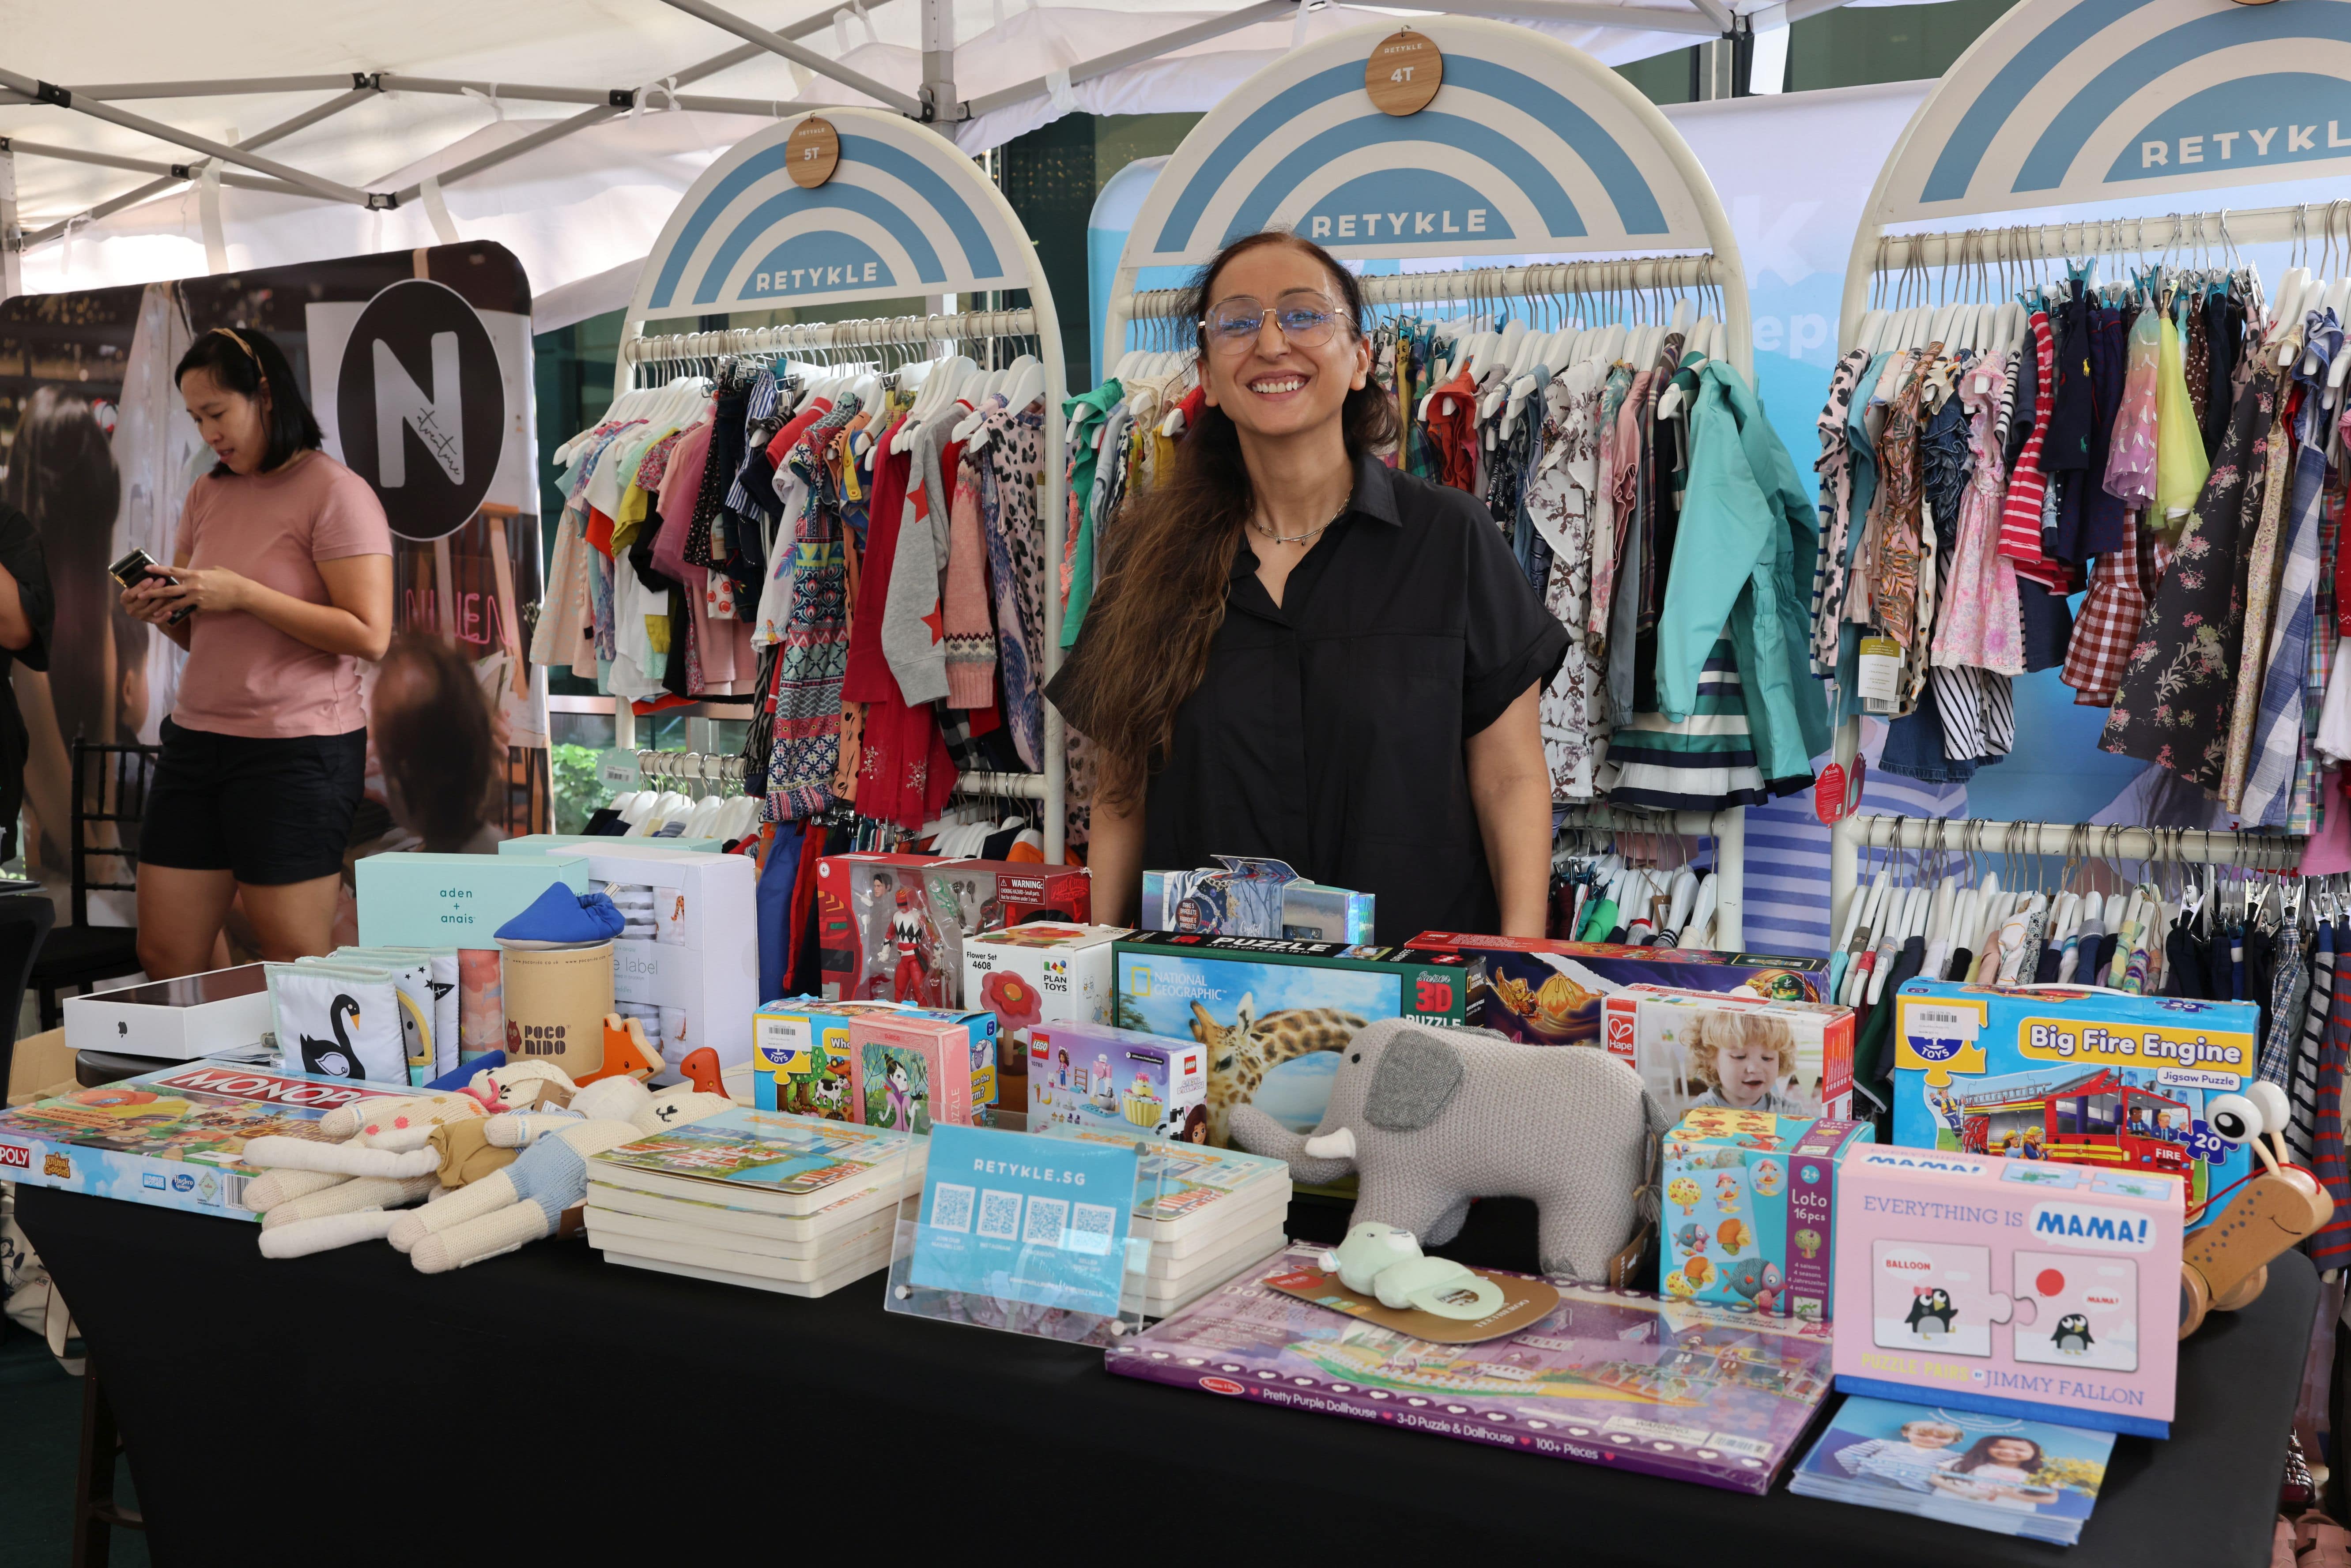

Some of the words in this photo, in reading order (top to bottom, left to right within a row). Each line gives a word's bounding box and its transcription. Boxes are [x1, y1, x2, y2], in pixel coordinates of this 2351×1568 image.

[1384, 42, 1423, 54] RETYKLE
[1391, 66, 1414, 83] 4T
[799, 127, 825, 136] RETYKLE
[2142, 120, 2351, 168] RETYKL
[804, 147, 819, 161] 5T
[1312, 208, 1487, 239] RETYKLE
[756, 262, 877, 292] RETYKLE
[373, 331, 464, 488] N
[1011, 879, 1043, 889] WARNING:
[440, 887, 472, 898] aden
[441, 914, 474, 924] anais
[1211, 937, 1332, 952] PUZZLE
[966, 951, 986, 960] Flower
[626, 957, 657, 975] label
[972, 961, 992, 970] 4608
[1043, 974, 1067, 984] PLAN
[1154, 971, 1208, 987] NATIONAL
[1417, 971, 1451, 984] Super
[1044, 983, 1067, 992] TOYS
[1153, 984, 1223, 1001] GEOGRAPHIC
[1415, 981, 1453, 1013] 3D
[525, 1025, 566, 1039] POCO
[525, 1040, 566, 1055] NIDO
[1032, 1040, 1049, 1052] LEGO
[1609, 1039, 1633, 1052] Hape
[2031, 1025, 2075, 1055] Big
[2083, 1029, 2136, 1055] Fire
[2143, 1033, 2242, 1066] Engine
[770, 1053, 789, 1063] TOYS
[1921, 1047, 1950, 1059] TOYS
[1185, 1060, 1196, 1070] LEGO
[973, 1078, 981, 1086] on
[980, 1073, 990, 1083] the
[2163, 1071, 2199, 1085] Jigsaw
[2202, 1074, 2234, 1086] Puzzle
[2194, 1132, 2221, 1151] 20
[2155, 1149, 2181, 1161] FIRE
[46, 1156, 68, 1168] Animal
[1867, 1156, 1981, 1173] MAMA!
[44, 1165, 71, 1179] Crossing
[974, 1159, 1086, 1186] RETYKLE.SG
[1802, 1168, 1819, 1180] 2+
[172, 1174, 193, 1186] Hasbro
[175, 1182, 190, 1191] Gaming
[1792, 1188, 1827, 1208] Loto
[1864, 1195, 1998, 1225] EVERYTHING
[2005, 1212, 2023, 1227] IS
[2036, 1210, 2148, 1244] MAMA!
[1886, 1259, 1931, 1271] BALLOON
[1792, 1278, 1827, 1287] Jahreszeiten
[1794, 1286, 1824, 1294] estaciones
[2086, 1295, 2119, 1305] MAMA!
[1861, 1353, 1917, 1375] PUZZLE
[1924, 1360, 1970, 1381] PAIRS
[1984, 1369, 2053, 1396] JIMMY
[2059, 1380, 2144, 1406] FALLON
[1263, 1388, 1292, 1404] Pretty
[1293, 1395, 1325, 1410] Purple
[1326, 1399, 1377, 1419] Dollhouse
[1397, 1413, 1416, 1426] 3-D
[1418, 1415, 1451, 1432] Puzzle
[1452, 1423, 1461, 1434] &
[1464, 1425, 1515, 1444] Dollhouse
[1536, 1437, 1561, 1452] 100+
[1563, 1444, 1599, 1460] Pieces
